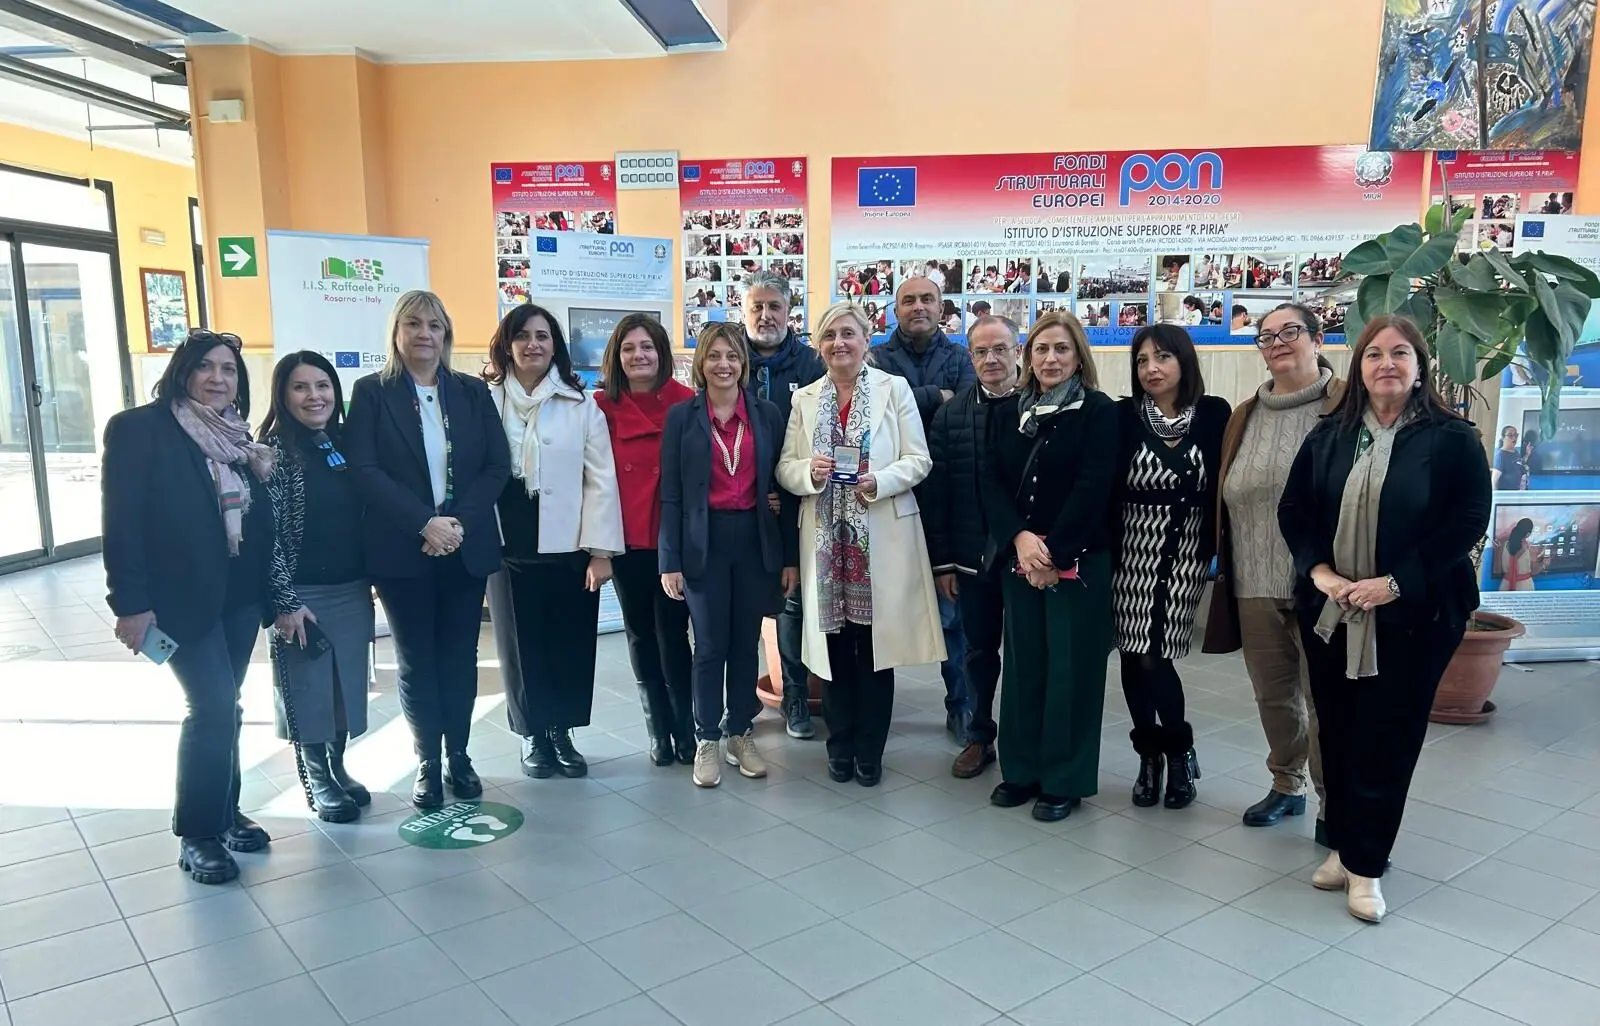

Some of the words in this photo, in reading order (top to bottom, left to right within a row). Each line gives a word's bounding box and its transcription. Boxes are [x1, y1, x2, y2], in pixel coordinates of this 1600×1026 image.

[1054, 155, 1107, 170] FONDI
[995, 174, 1106, 191] STRUTTURALI
[1120, 152, 1224, 208] pon
[1032, 193, 1105, 208] EUROPEI
[1148, 194, 1221, 206] 2014-2020
[1004, 227, 1049, 239] ISTITUTO
[1052, 225, 1124, 238] D'ISTRUZIONE
[1126, 224, 1182, 237] SUPERIORE
[1185, 223, 1229, 236] "R.PIRIA"
[610, 241, 634, 256] pon
[541, 268, 567, 276] ISTITUTO
[568, 270, 608, 278] D'ISTRUZIONE
[303, 280, 328, 291] I.I.S.
[331, 281, 374, 292] Raffaele
[377, 282, 400, 293] Piria
[324, 294, 357, 303] Rosarno
[365, 295, 382, 305] Italy
[362, 352, 387, 363] Eras
[401, 802, 475, 832] ENTRATA
